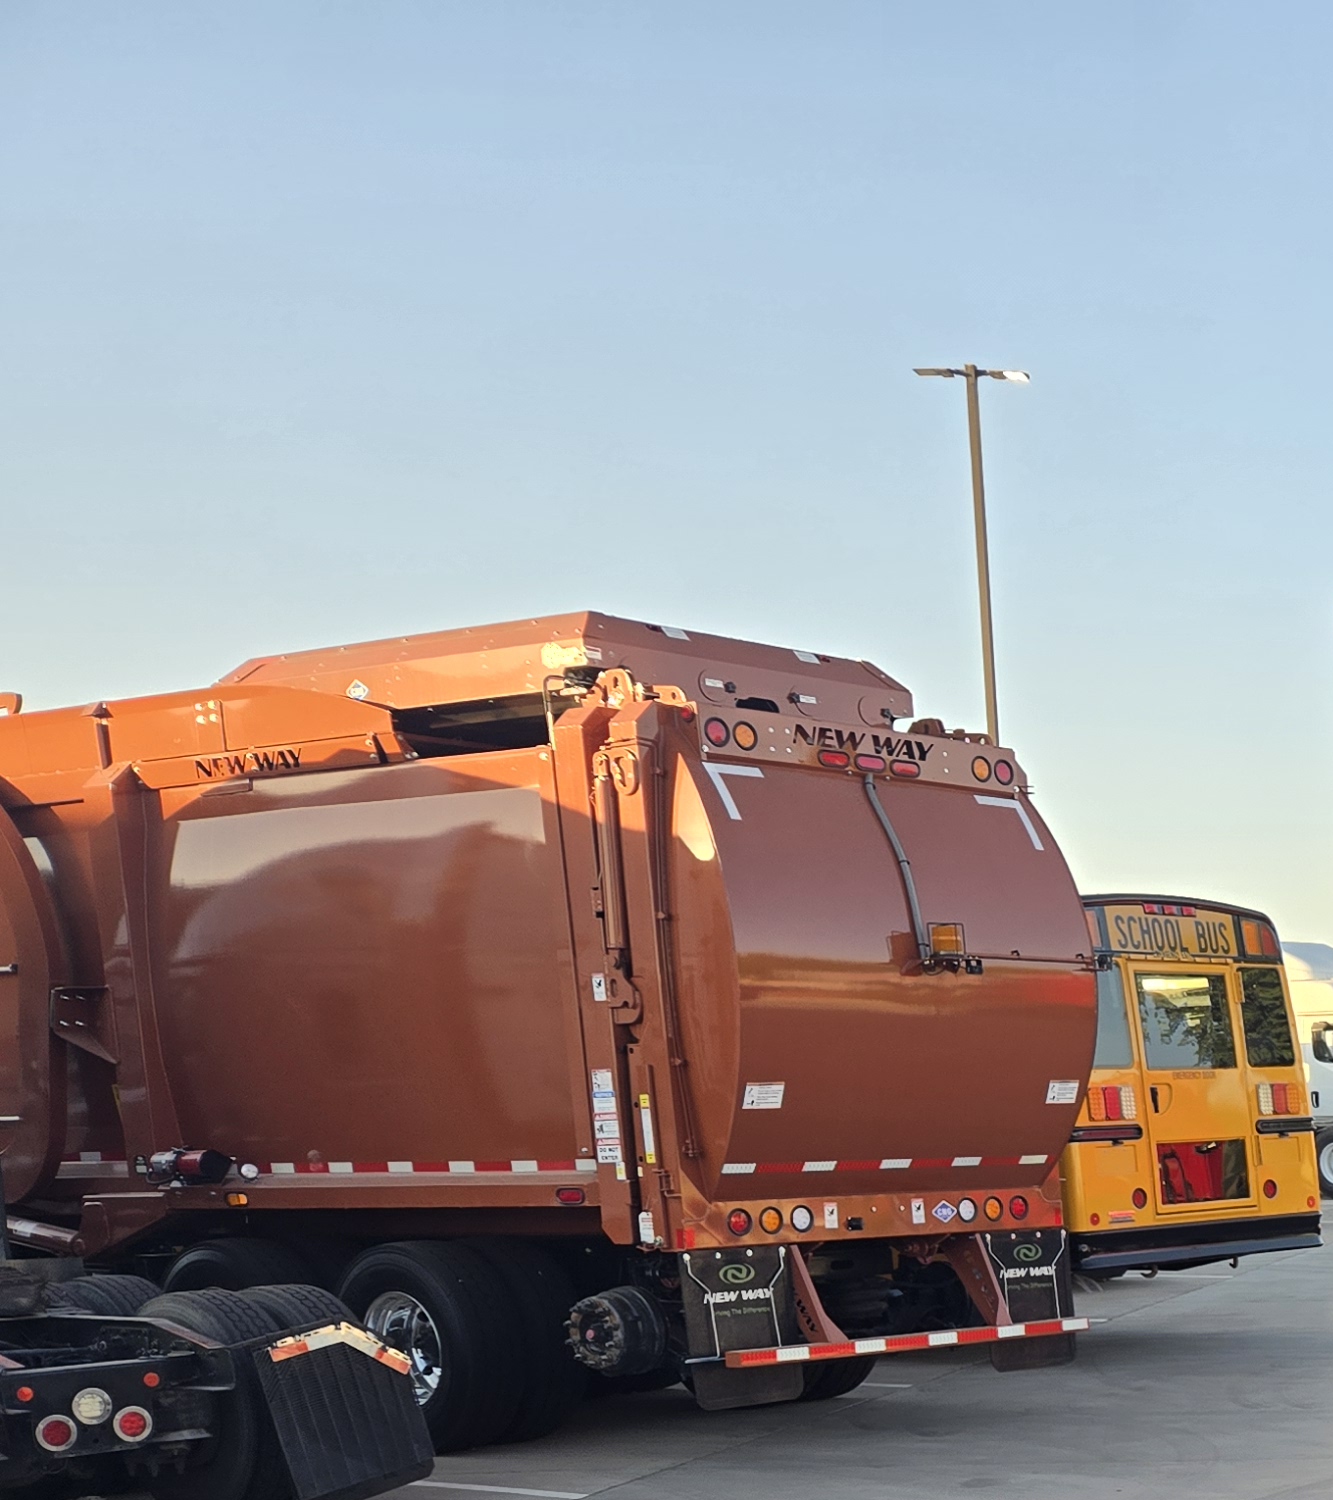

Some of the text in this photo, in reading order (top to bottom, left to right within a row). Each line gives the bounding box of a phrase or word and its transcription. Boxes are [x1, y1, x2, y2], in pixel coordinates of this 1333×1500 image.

[793, 724, 934, 761] NEW WAY
[195, 748, 302, 778] NEW WAY
[1114, 915, 1231, 954] SCHOOL BUS
[703, 1287, 774, 1304] NEW WAY
